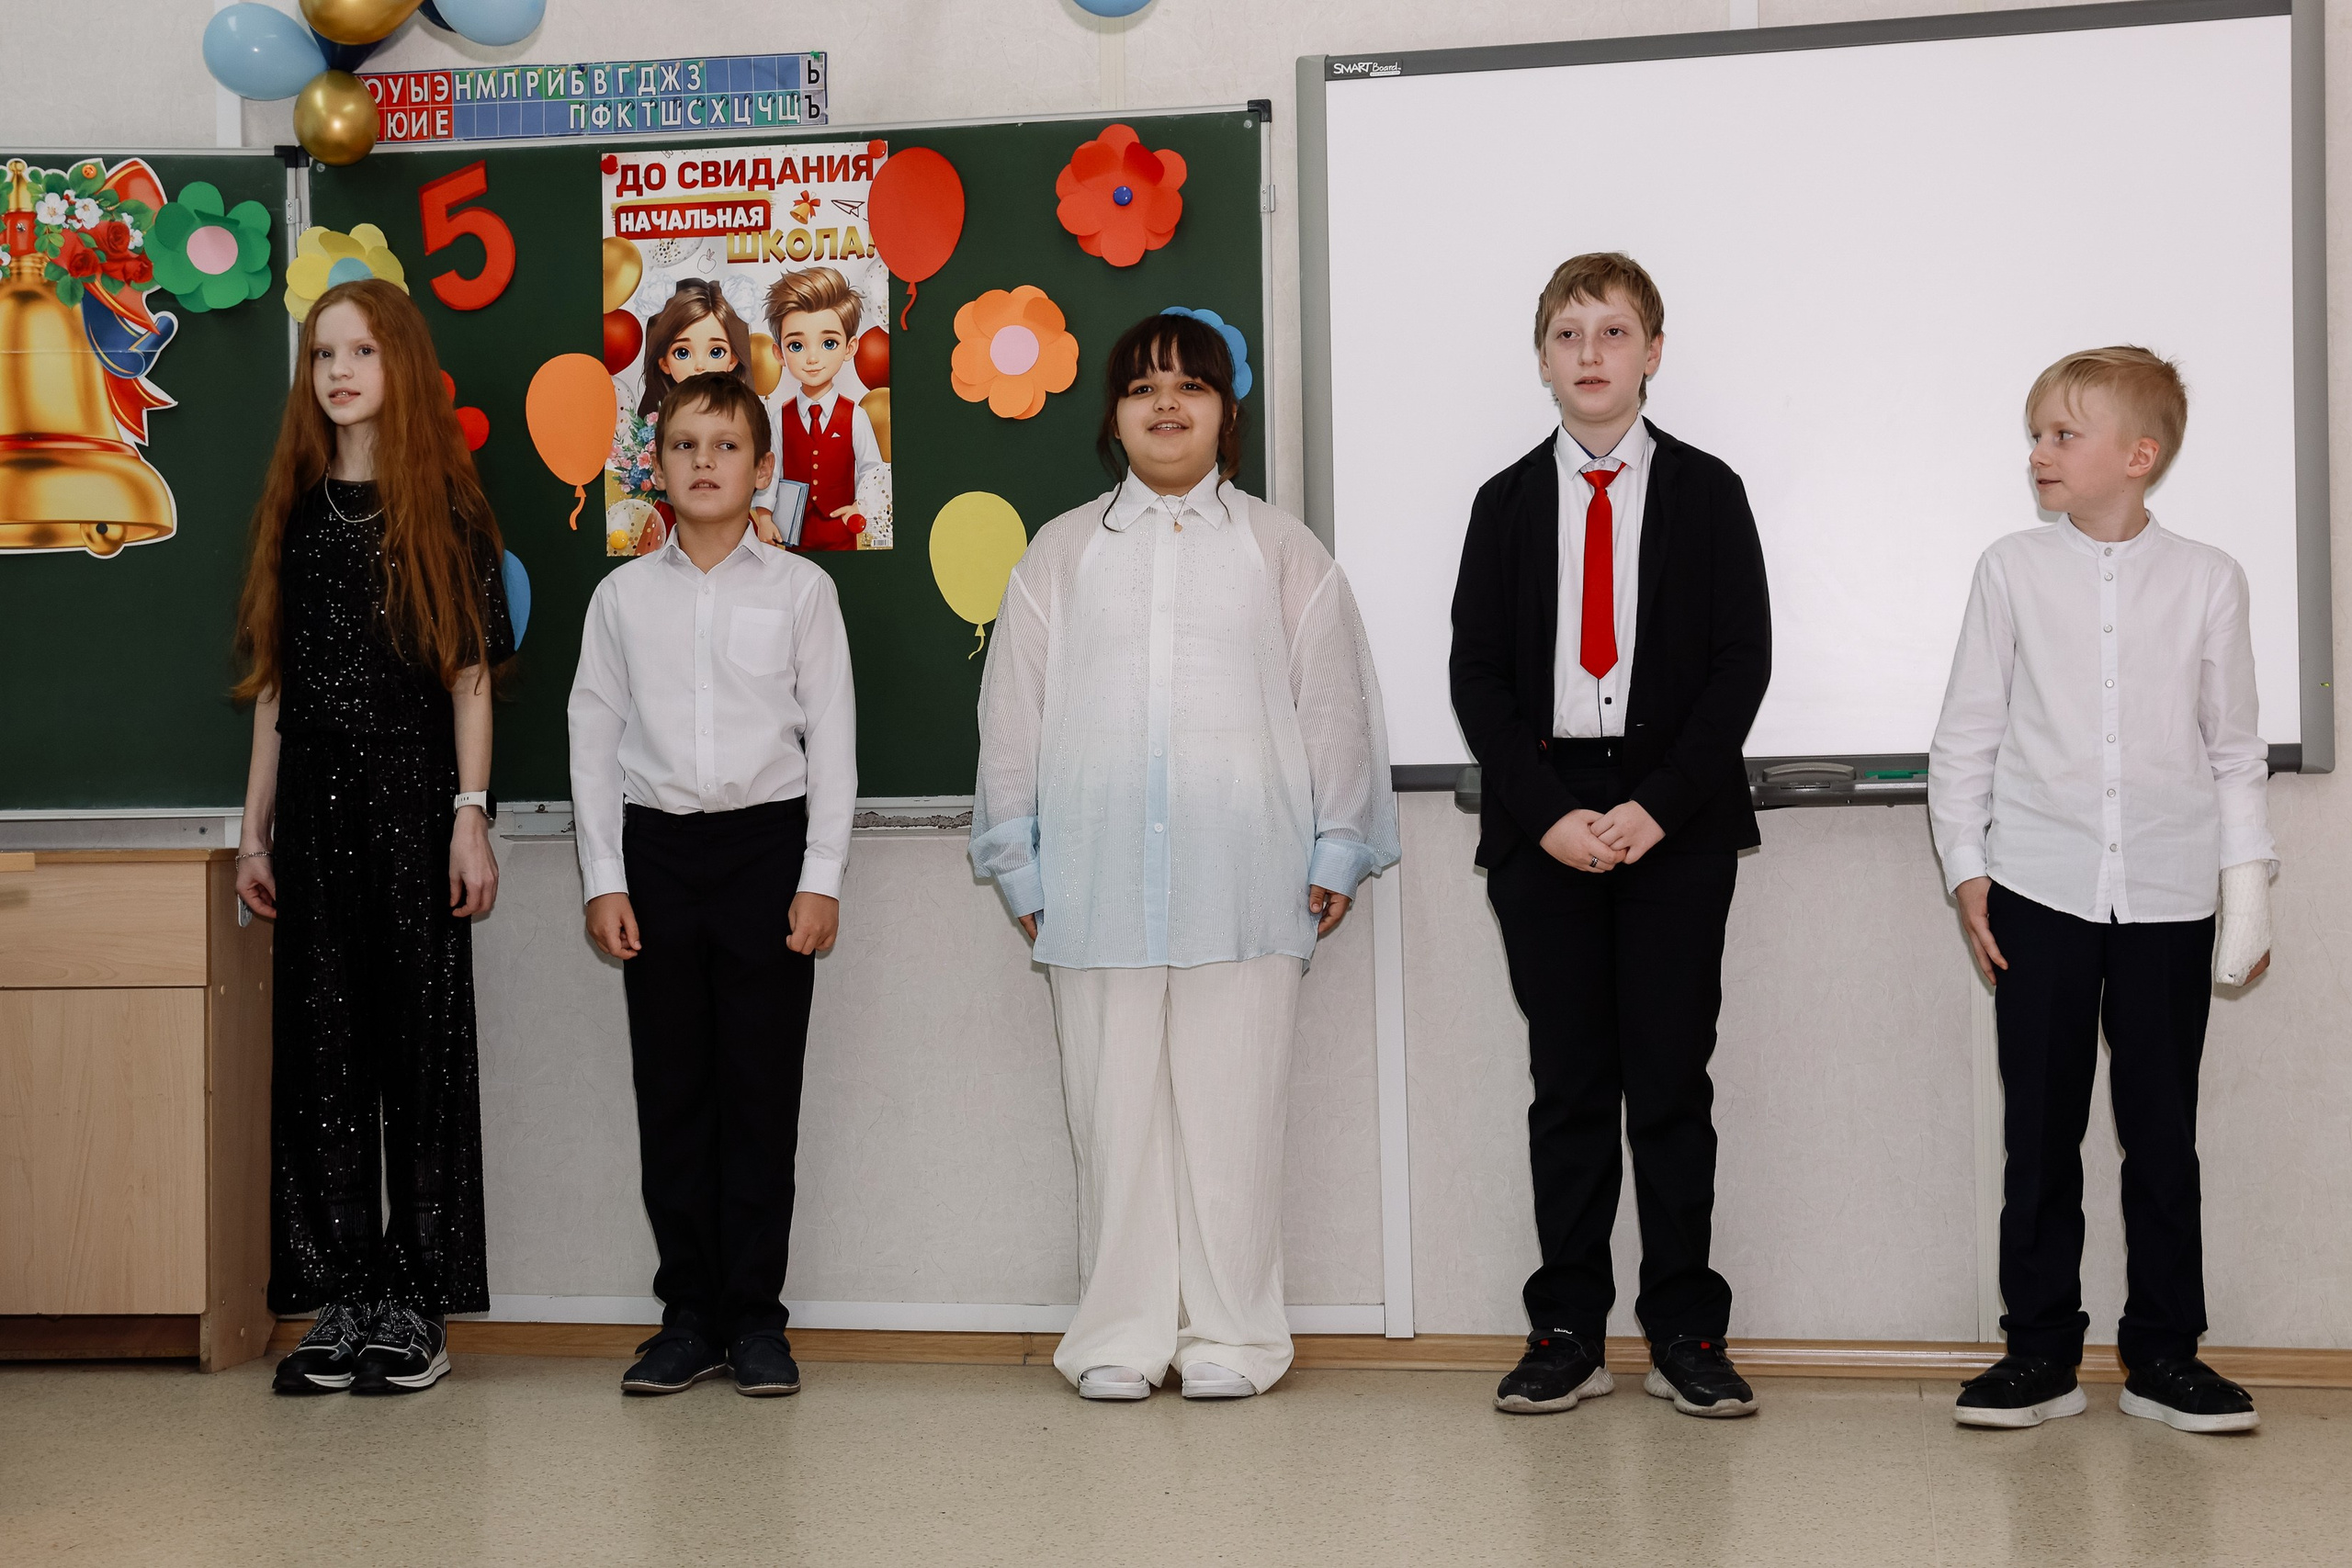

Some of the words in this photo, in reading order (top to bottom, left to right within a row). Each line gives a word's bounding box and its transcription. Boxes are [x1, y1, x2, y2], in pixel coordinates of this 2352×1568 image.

[1333, 62, 1374, 74] SMART
[616, 163, 666, 197] ДО
[677, 153, 874, 191] СВИДАНИЯ
[418, 159, 516, 311] 5
[619, 207, 765, 233] НАЧАЛЬНАЯ
